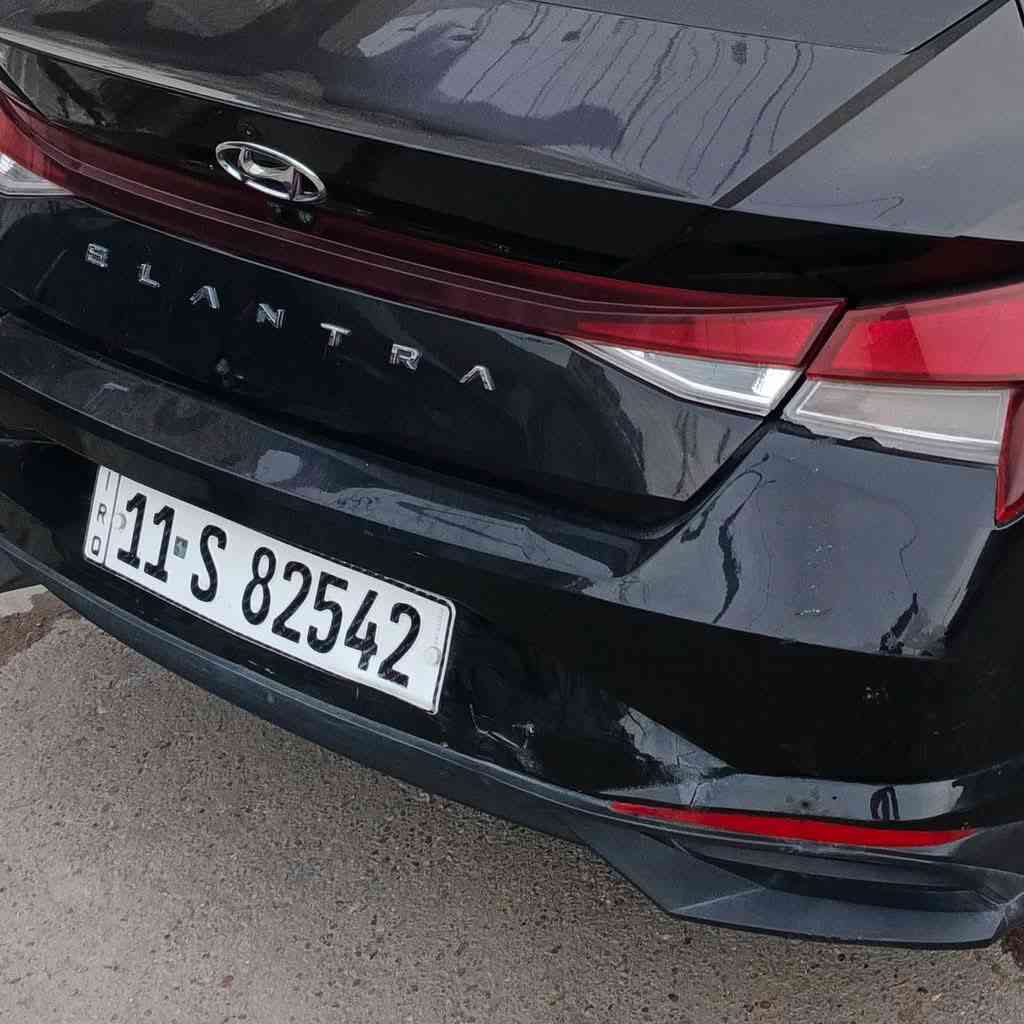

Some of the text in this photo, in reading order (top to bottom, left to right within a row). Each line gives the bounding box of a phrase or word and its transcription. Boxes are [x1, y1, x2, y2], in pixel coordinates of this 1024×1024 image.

[86, 243, 496, 392] ELANTRA
[117, 492, 422, 688] 11 S 82542
